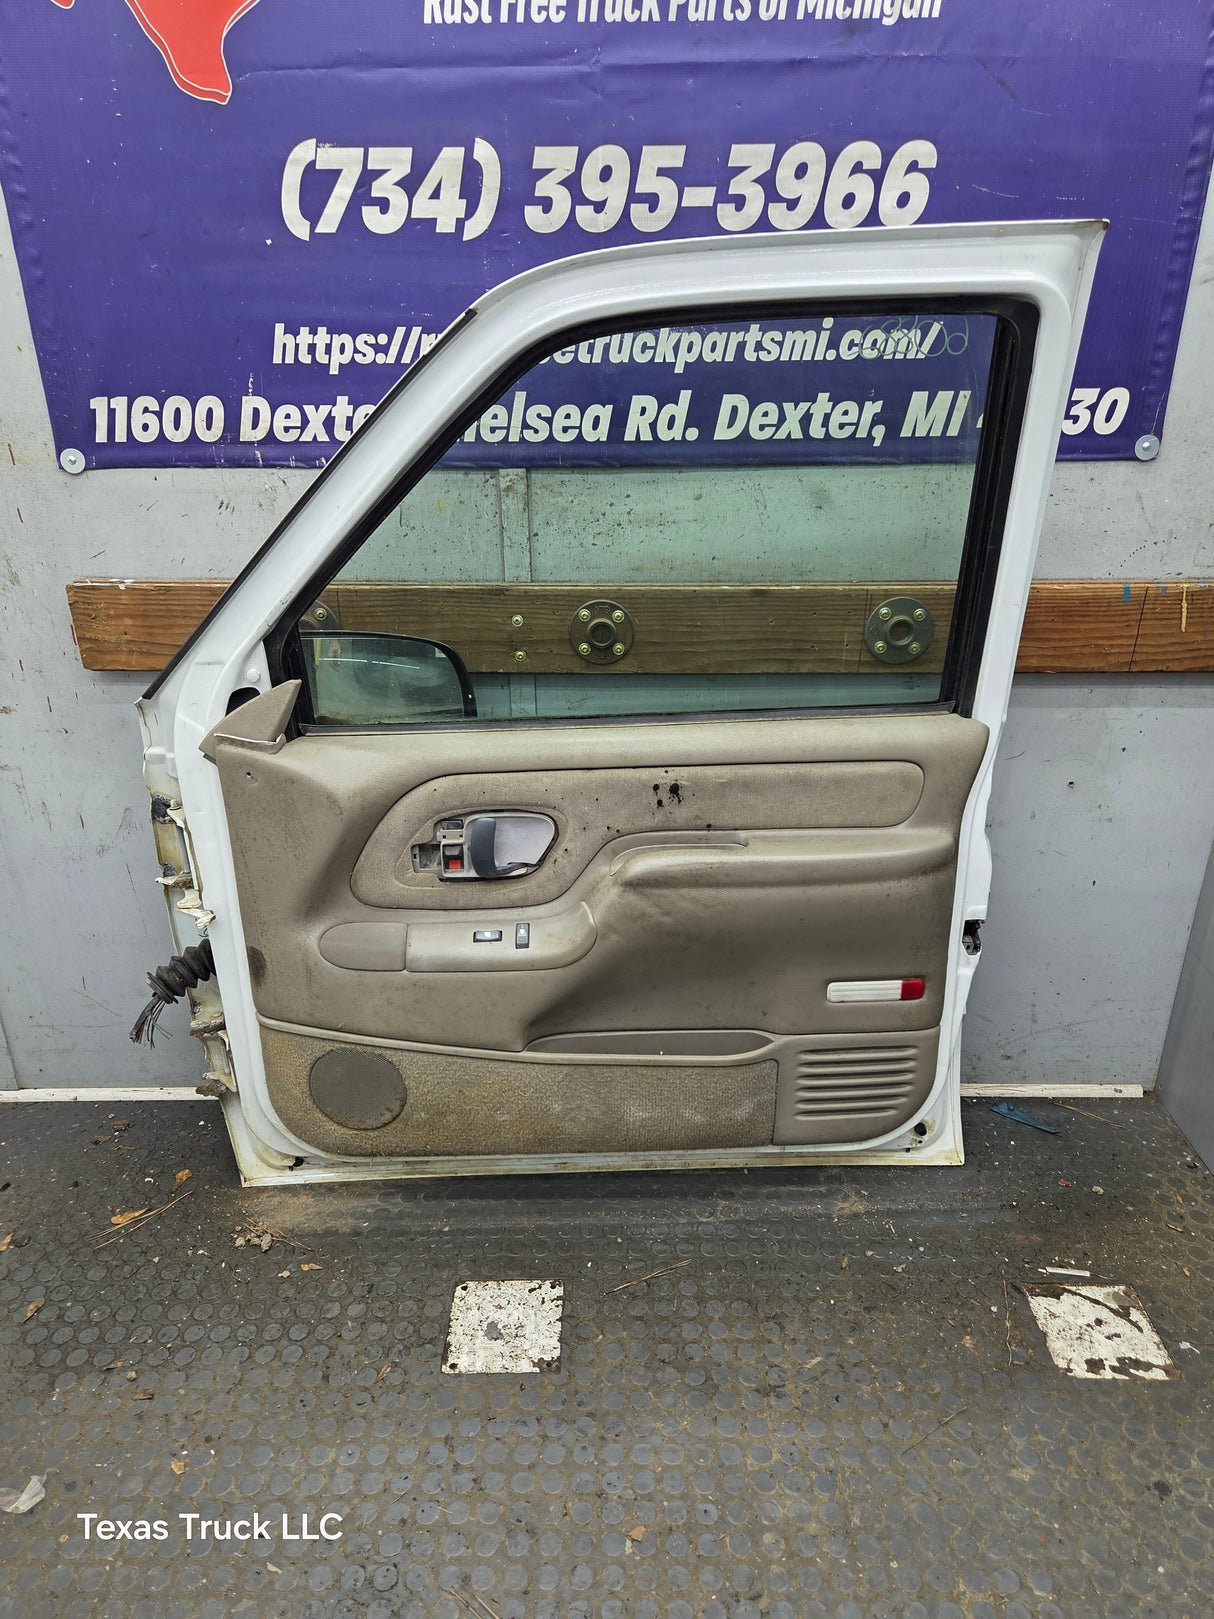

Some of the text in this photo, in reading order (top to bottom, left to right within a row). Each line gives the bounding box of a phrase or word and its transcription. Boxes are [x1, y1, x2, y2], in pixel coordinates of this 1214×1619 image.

[423, 0, 492, 24] Rust
[281, 137, 938, 241] (734) 395-3966
[89, 395, 225, 443] 11600
[239, 395, 378, 442] Dext
[459, 391, 613, 442] elsea
[623, 389, 699, 442] Rd.
[713, 391, 885, 447] Dexter,
[900, 390, 972, 437] MI
